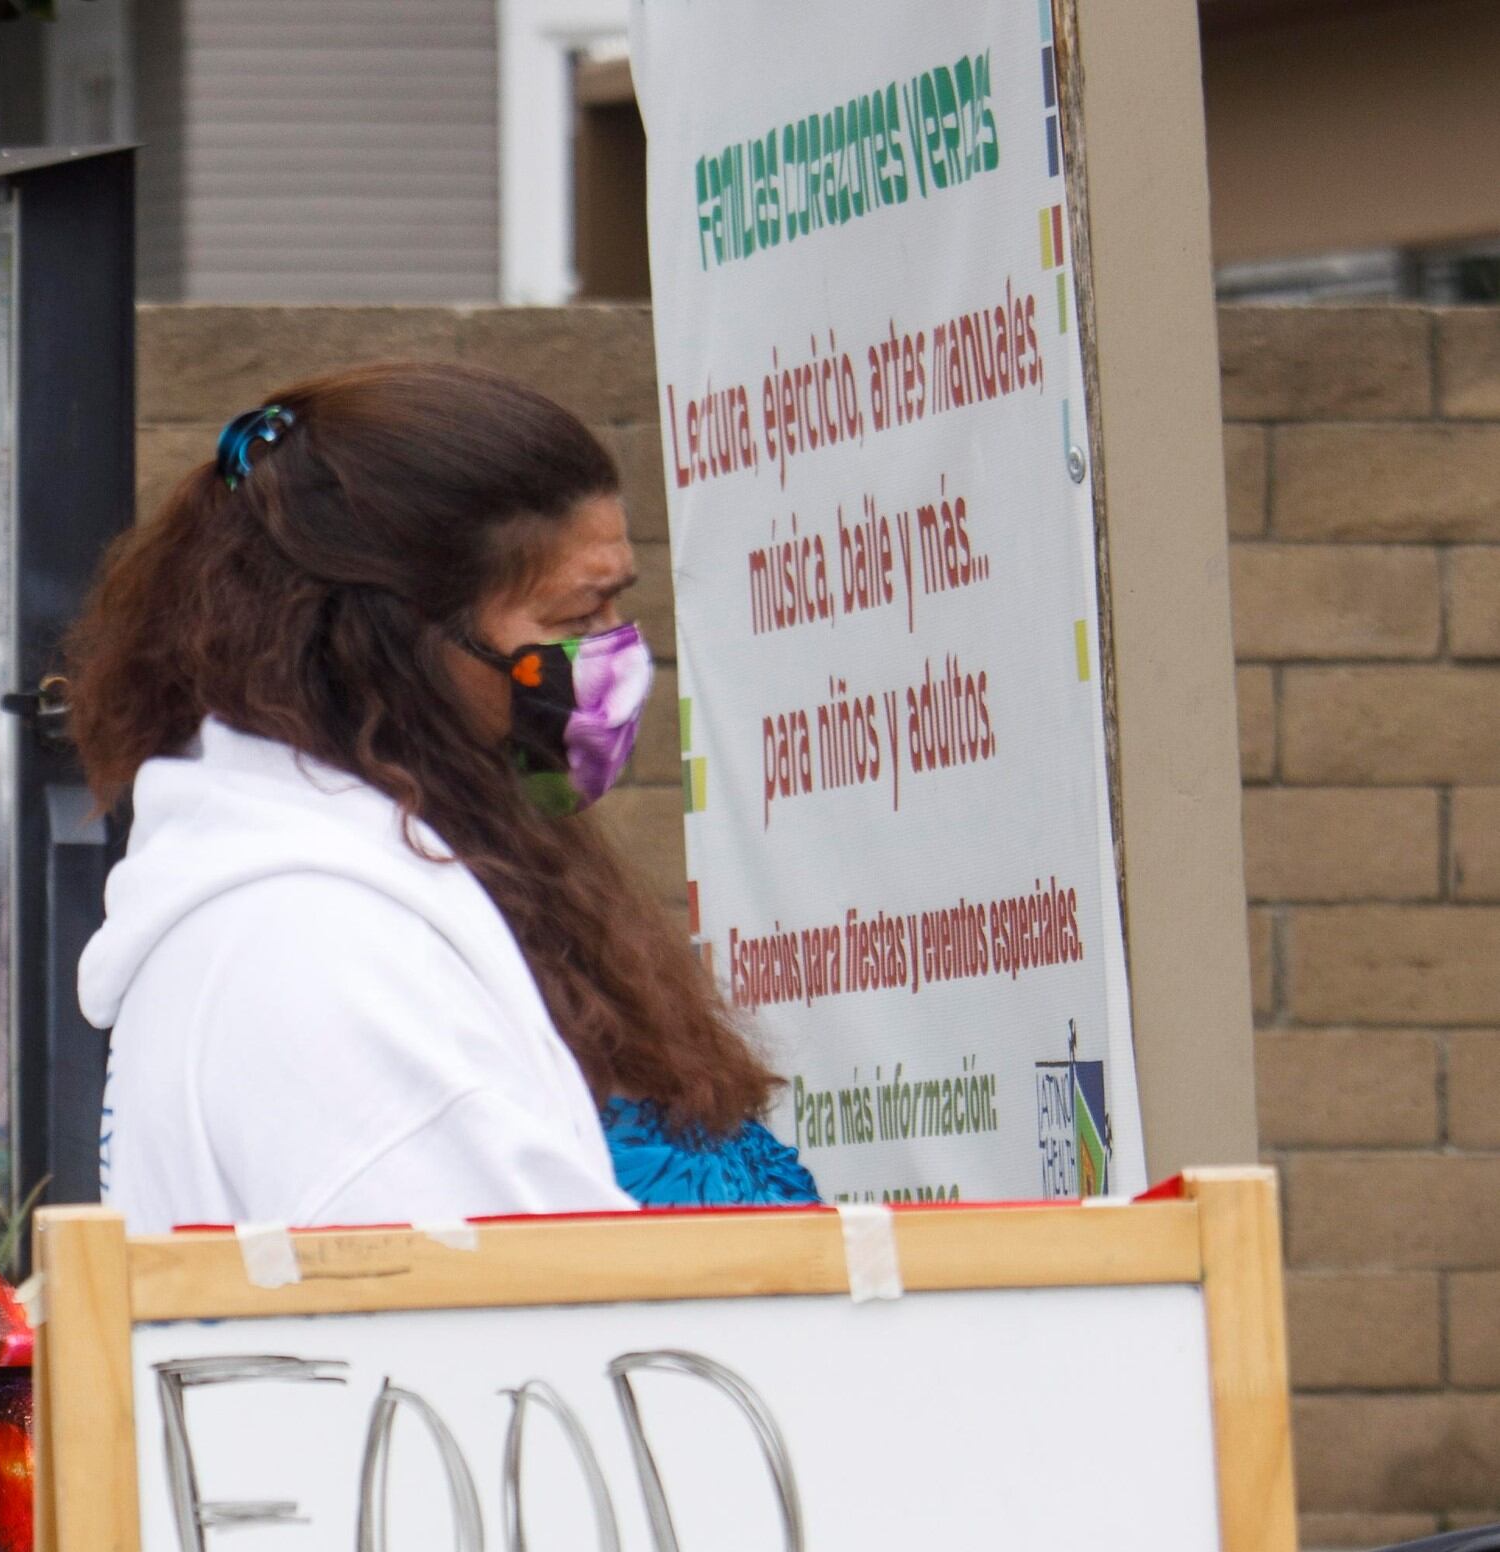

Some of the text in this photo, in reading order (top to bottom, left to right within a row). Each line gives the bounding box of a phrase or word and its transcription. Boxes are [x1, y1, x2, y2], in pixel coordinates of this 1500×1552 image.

[667, 275, 1044, 491] Lectura, ejercicio, artes manuales,
[748, 473, 989, 635] música, baile y más...
[762, 651, 996, 832] para niños y adultos.
[729, 876, 1083, 1016] Espacios para fiestas y eventos especiales.
[793, 1054, 997, 1149] Para más información:
